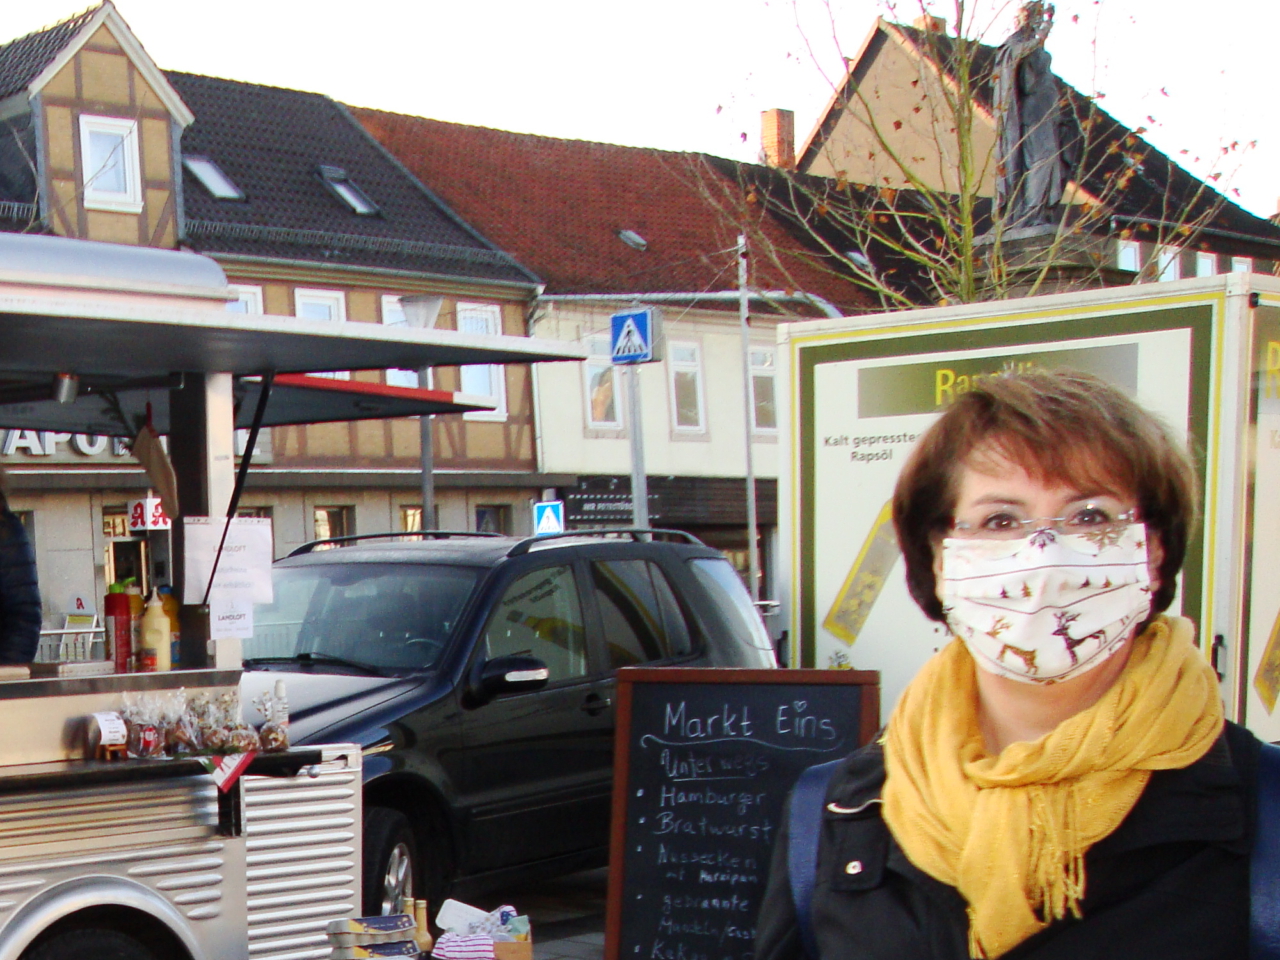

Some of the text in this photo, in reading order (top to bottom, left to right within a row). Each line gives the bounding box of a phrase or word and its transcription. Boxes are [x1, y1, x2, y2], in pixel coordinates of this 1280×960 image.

[823, 434, 849, 447] Kalt
[850, 449, 893, 464] Rapsöl
[663, 700, 836, 740] Markt Eins
[659, 785, 767, 816] Hamburger
[652, 811, 773, 844] Bratwurst
